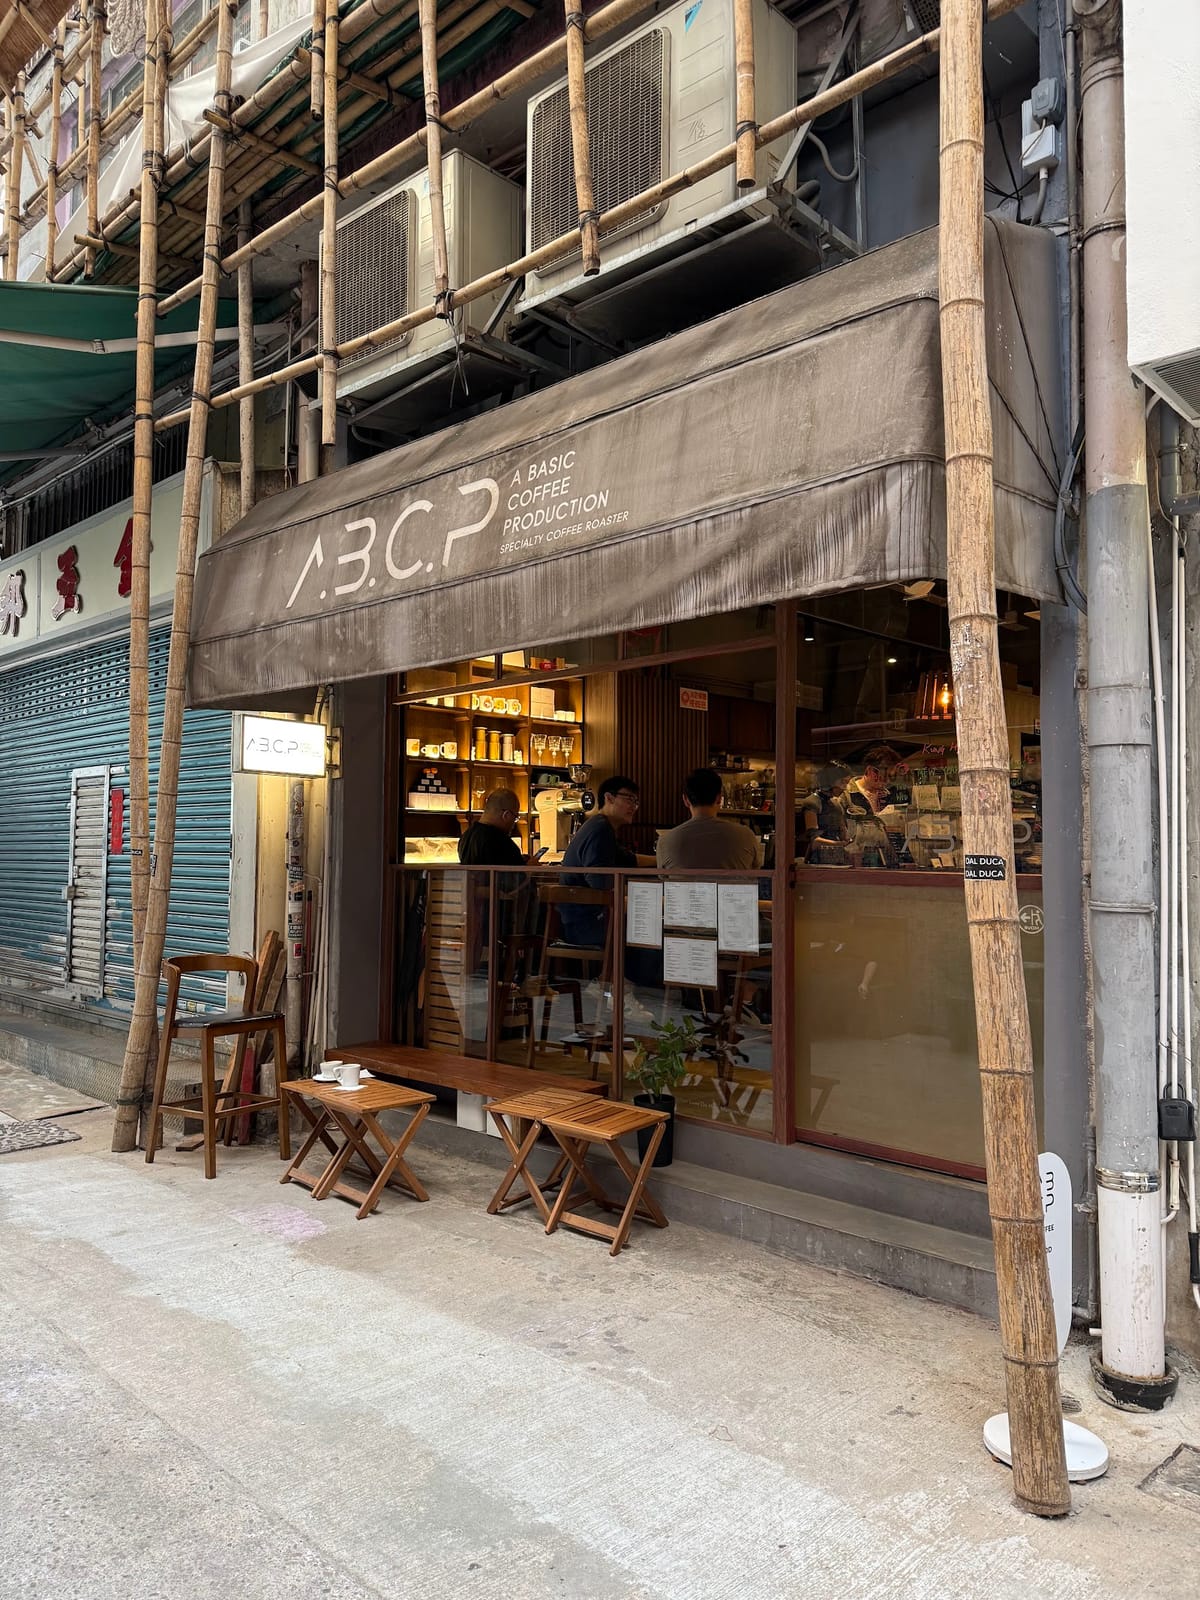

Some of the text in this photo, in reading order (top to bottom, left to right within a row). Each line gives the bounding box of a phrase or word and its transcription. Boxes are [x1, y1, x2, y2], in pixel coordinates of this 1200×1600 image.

[510, 450, 576, 488] A BASIC
[507, 475, 571, 511] COFFEE
[502, 489, 610, 537] PRODUCTION
[499, 510, 630, 554] SPECIALTY COFFEE ROASTER
[979, 857, 1004, 866] DUCA
[979, 869, 1004, 878] DUCA
